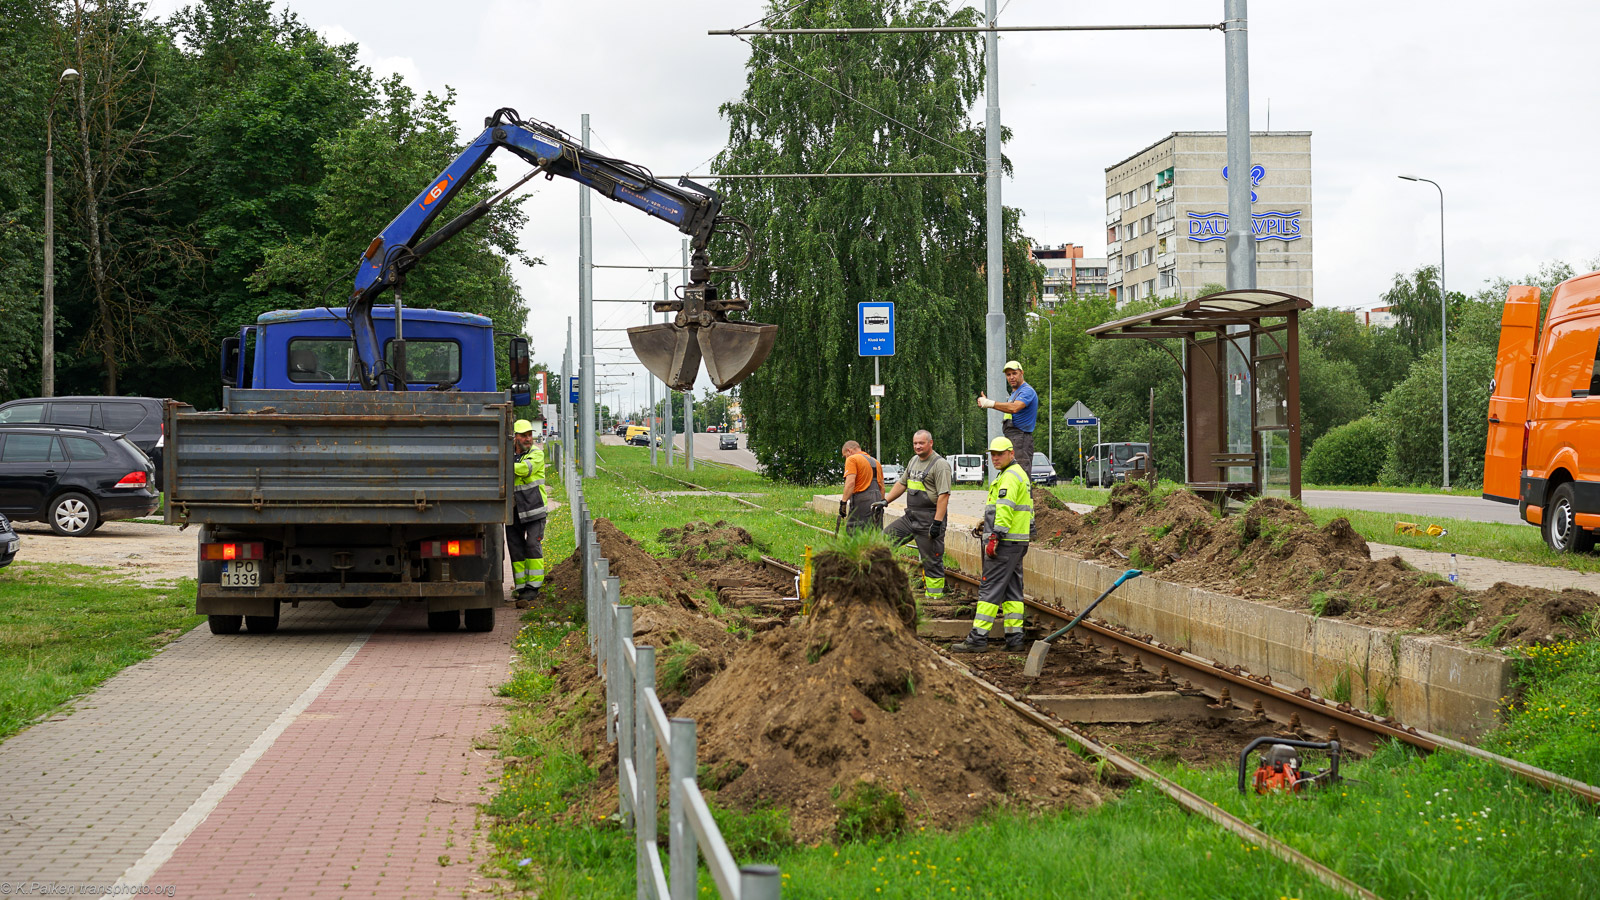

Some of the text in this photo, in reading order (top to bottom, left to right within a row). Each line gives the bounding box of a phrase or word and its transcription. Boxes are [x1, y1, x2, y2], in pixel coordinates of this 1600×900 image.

[430, 185, 442, 199] 6
[1189, 218, 1300, 234] DAUVPILS
[235, 561, 254, 573] PO
[227, 573, 257, 585] 1339
